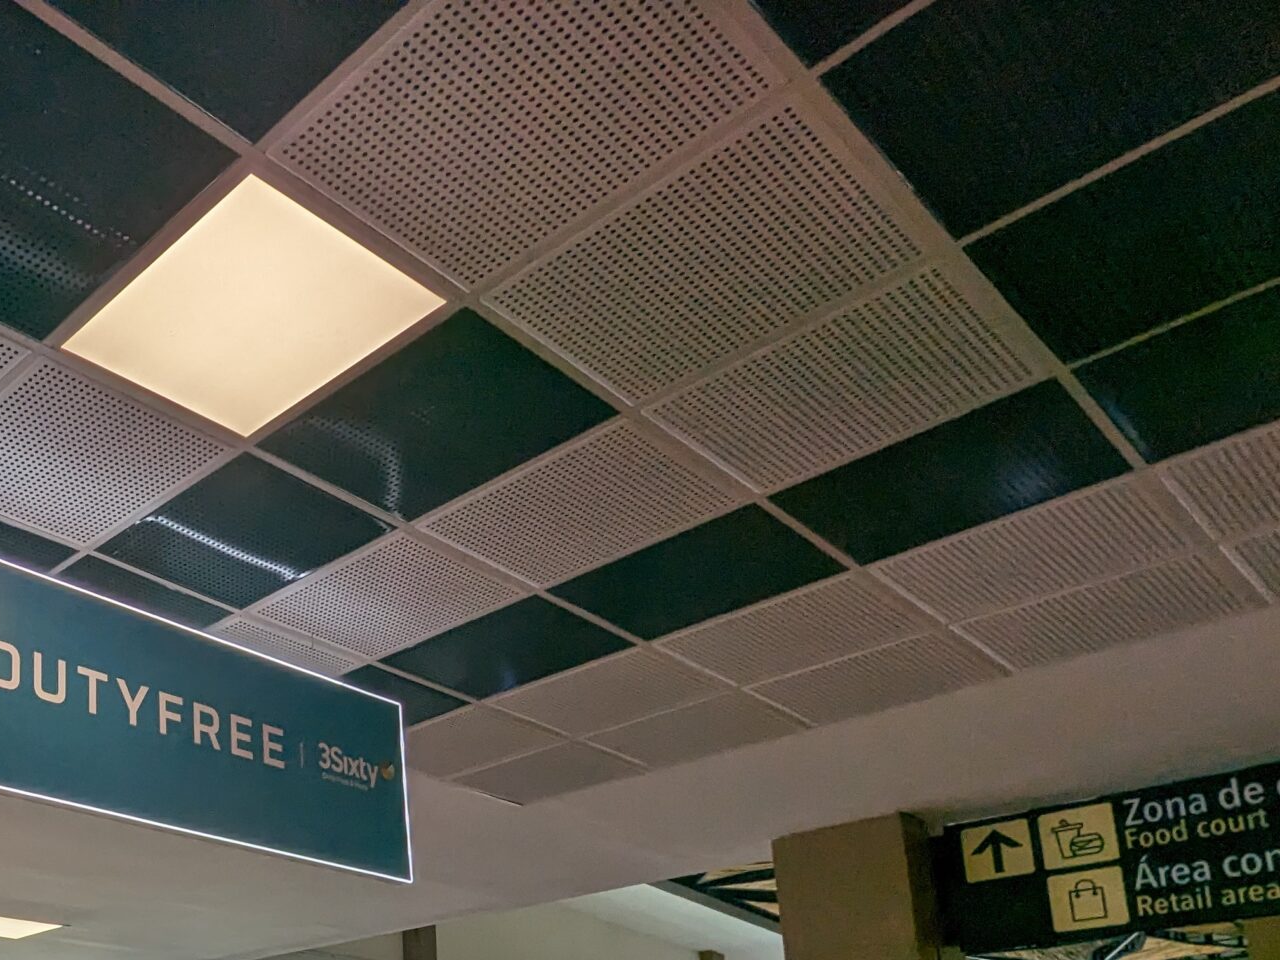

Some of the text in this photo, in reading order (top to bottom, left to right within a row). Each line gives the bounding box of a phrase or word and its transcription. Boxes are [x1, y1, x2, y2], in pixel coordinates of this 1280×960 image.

[318, 742, 379, 788] 3Sixty
[1123, 790, 1208, 827] Zona
[1218, 778, 1265, 808] de
[1124, 808, 1269, 849] Food court
[1135, 854, 1212, 891] Área
[1136, 882, 1280, 917] Retail area
